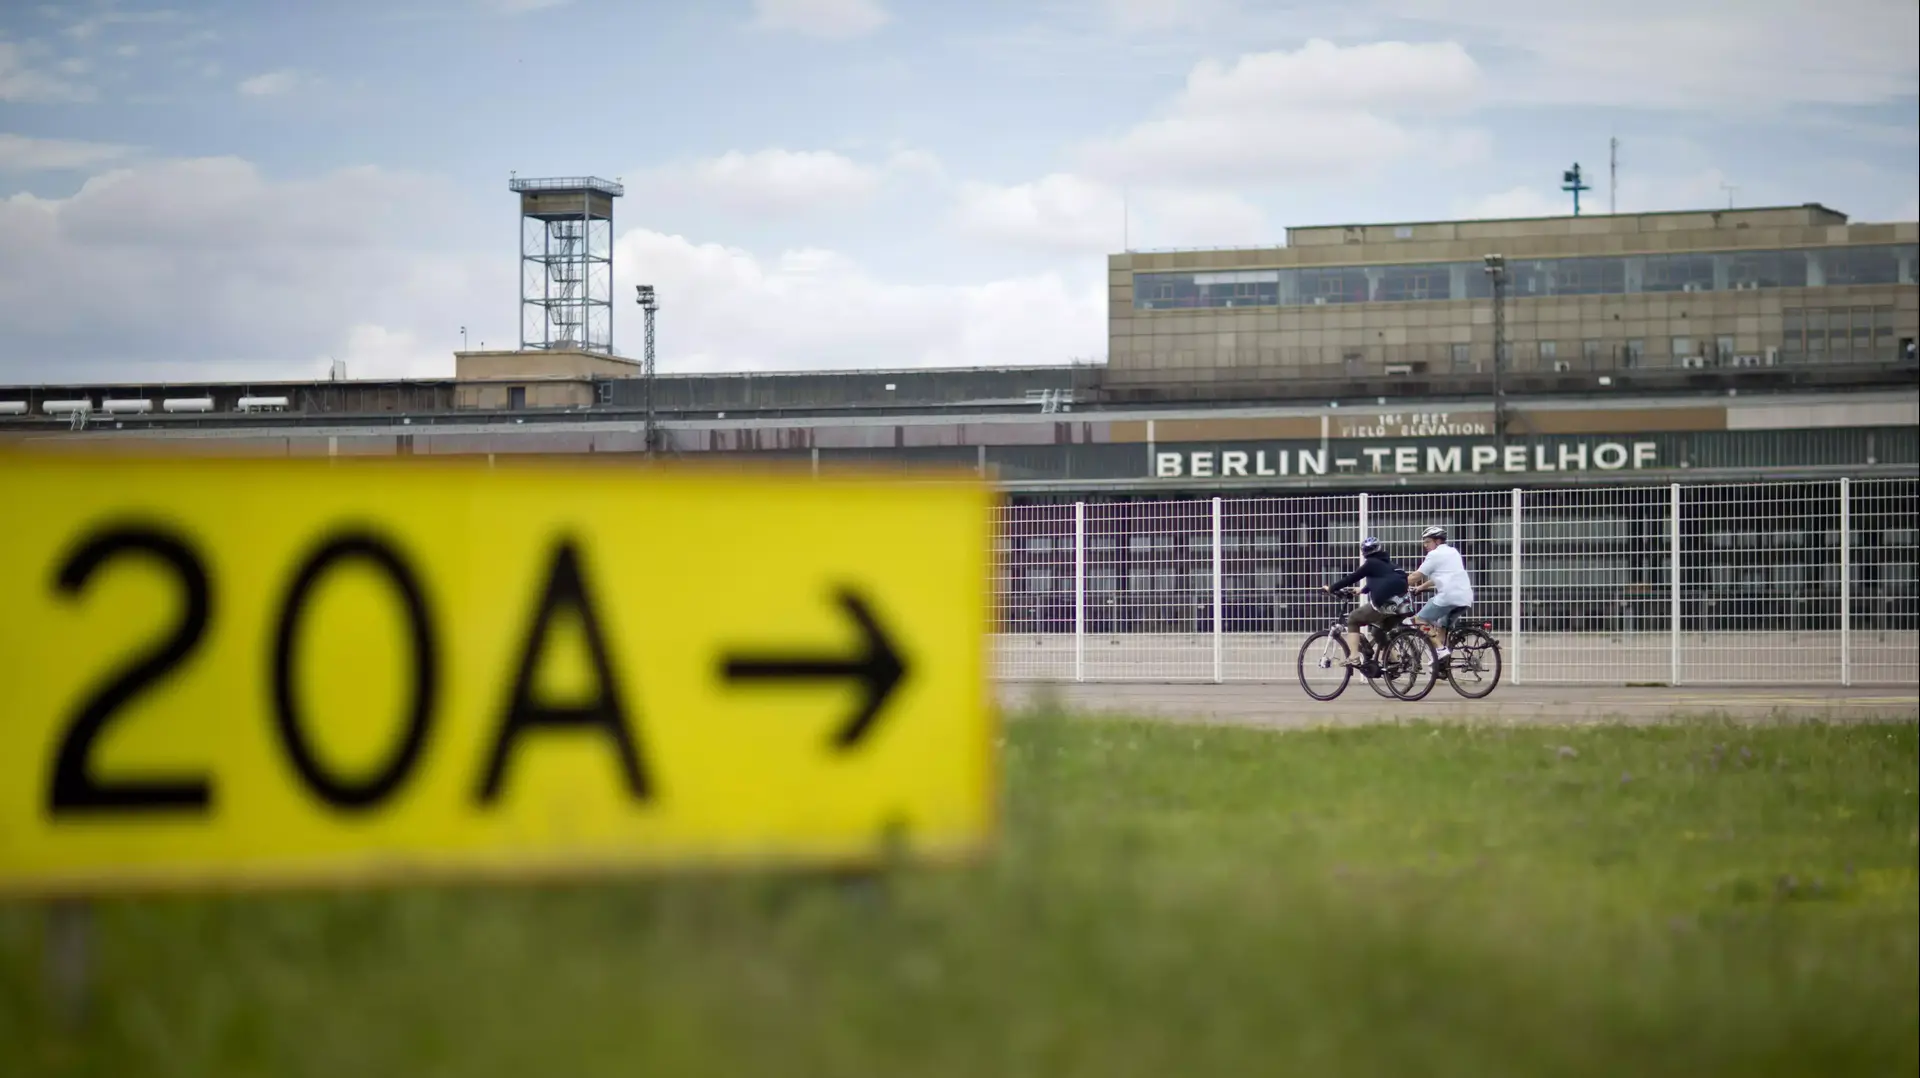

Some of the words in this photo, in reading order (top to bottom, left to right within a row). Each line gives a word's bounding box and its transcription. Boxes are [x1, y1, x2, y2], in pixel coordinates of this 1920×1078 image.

[1412, 413, 1449, 424] FEET
[1342, 425, 1386, 437] FIELD
[1401, 423, 1486, 436] ELEVATION
[47, 519, 658, 816] 20A
